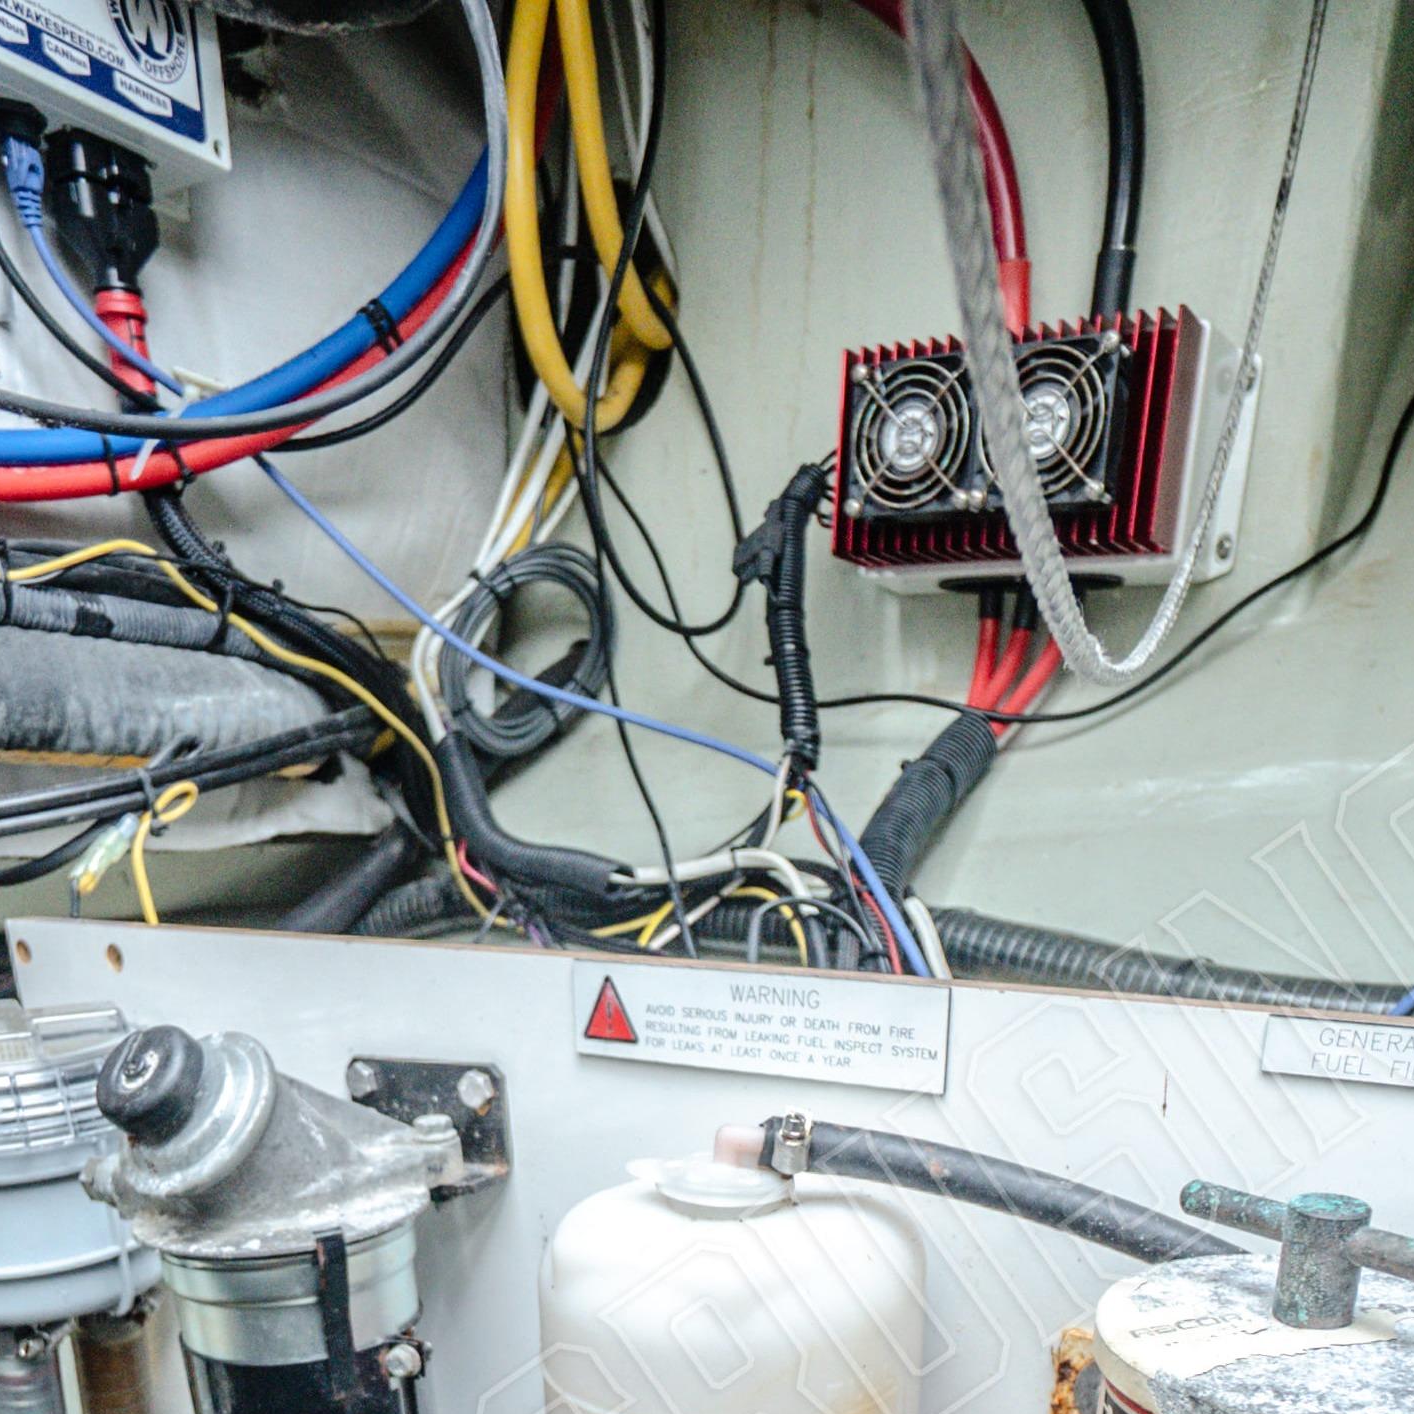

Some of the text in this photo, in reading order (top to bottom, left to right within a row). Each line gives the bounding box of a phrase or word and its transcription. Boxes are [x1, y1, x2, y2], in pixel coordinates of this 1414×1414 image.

[46, 39, 87, 68] CANbus
[144, 37, 186, 79] OFFSHORE
[119, 77, 169, 111] HARNESS
[730, 984, 820, 1009] WARNING
[646, 1004, 915, 1040] AVOID SERIOUS INJURY OR DEATH FROM FIRE
[646, 1021, 701, 1036] RESULTING
[707, 1026, 737, 1040] FROM
[745, 1031, 790, 1045] LEAKING
[834, 1040, 883, 1055] INSPECT
[891, 1045, 938, 1060] SYSTEM
[646, 1036, 851, 1068] FOR LEAKS AT LEAST ONCE A YEAR
[1311, 1052, 1372, 1076] FUEL
